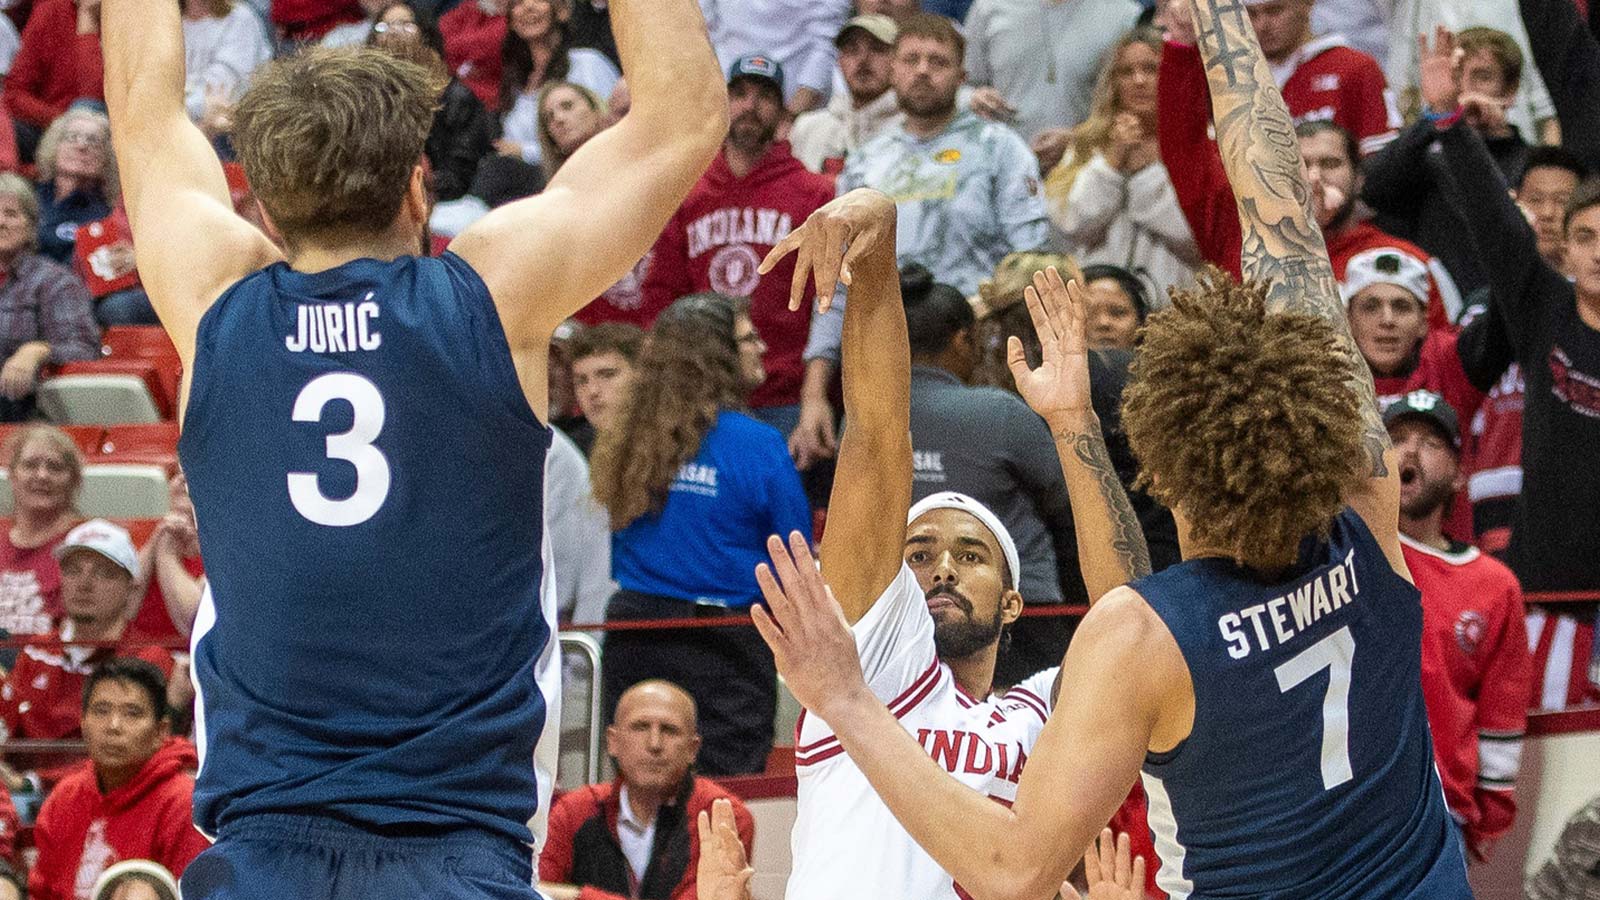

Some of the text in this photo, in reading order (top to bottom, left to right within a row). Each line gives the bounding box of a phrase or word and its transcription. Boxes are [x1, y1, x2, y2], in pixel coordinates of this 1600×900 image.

[285, 292, 381, 353] JURIĆ
[287, 372, 391, 527] 3
[1218, 548, 1359, 660] STEWART
[1273, 625, 1356, 791] 7
